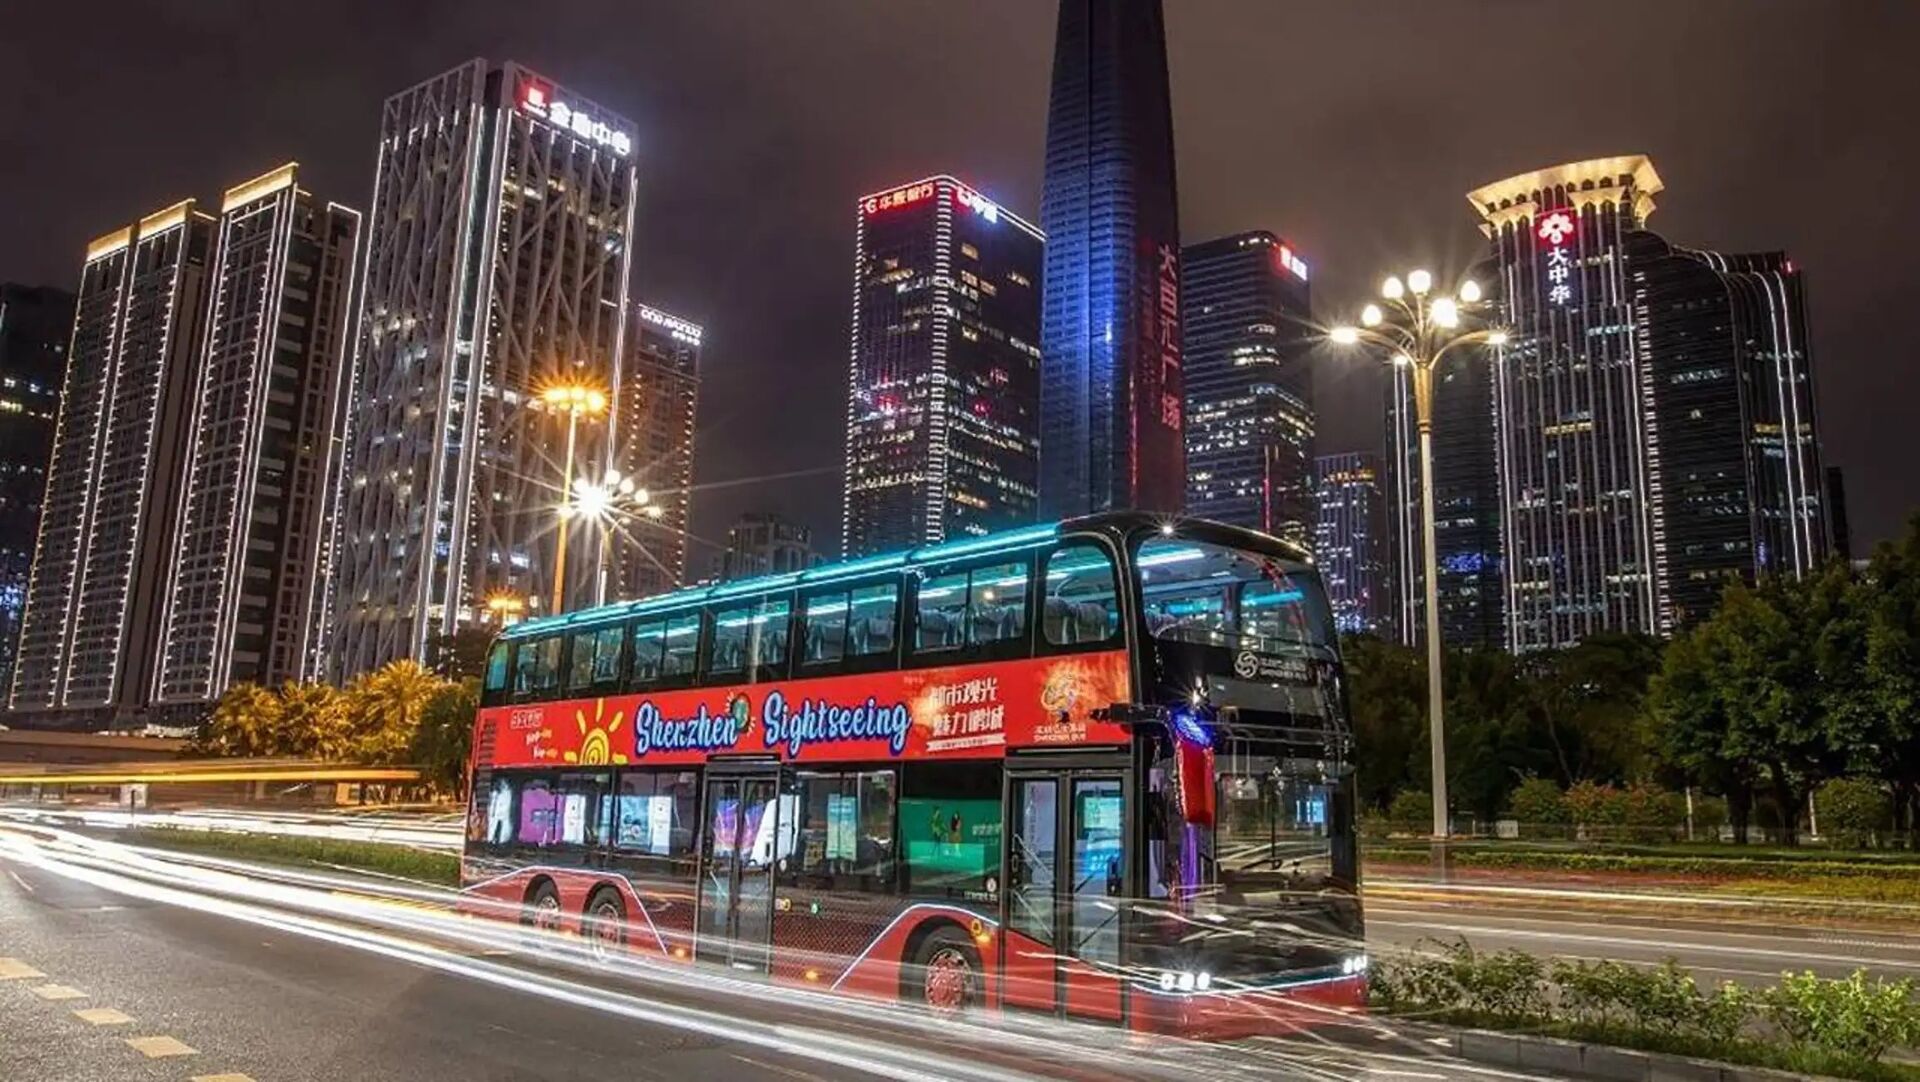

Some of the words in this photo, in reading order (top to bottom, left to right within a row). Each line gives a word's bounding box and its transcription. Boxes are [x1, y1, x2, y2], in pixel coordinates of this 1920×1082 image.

[1547, 246, 1571, 304] 大中华
[1158, 244, 1180, 430] 大百汇广场
[929, 677, 999, 708] 都市观光
[932, 704, 1005, 737] 魅力鹏城
[634, 699, 738, 757] Shenzhen
[762, 688, 912, 758] Sightseeing
